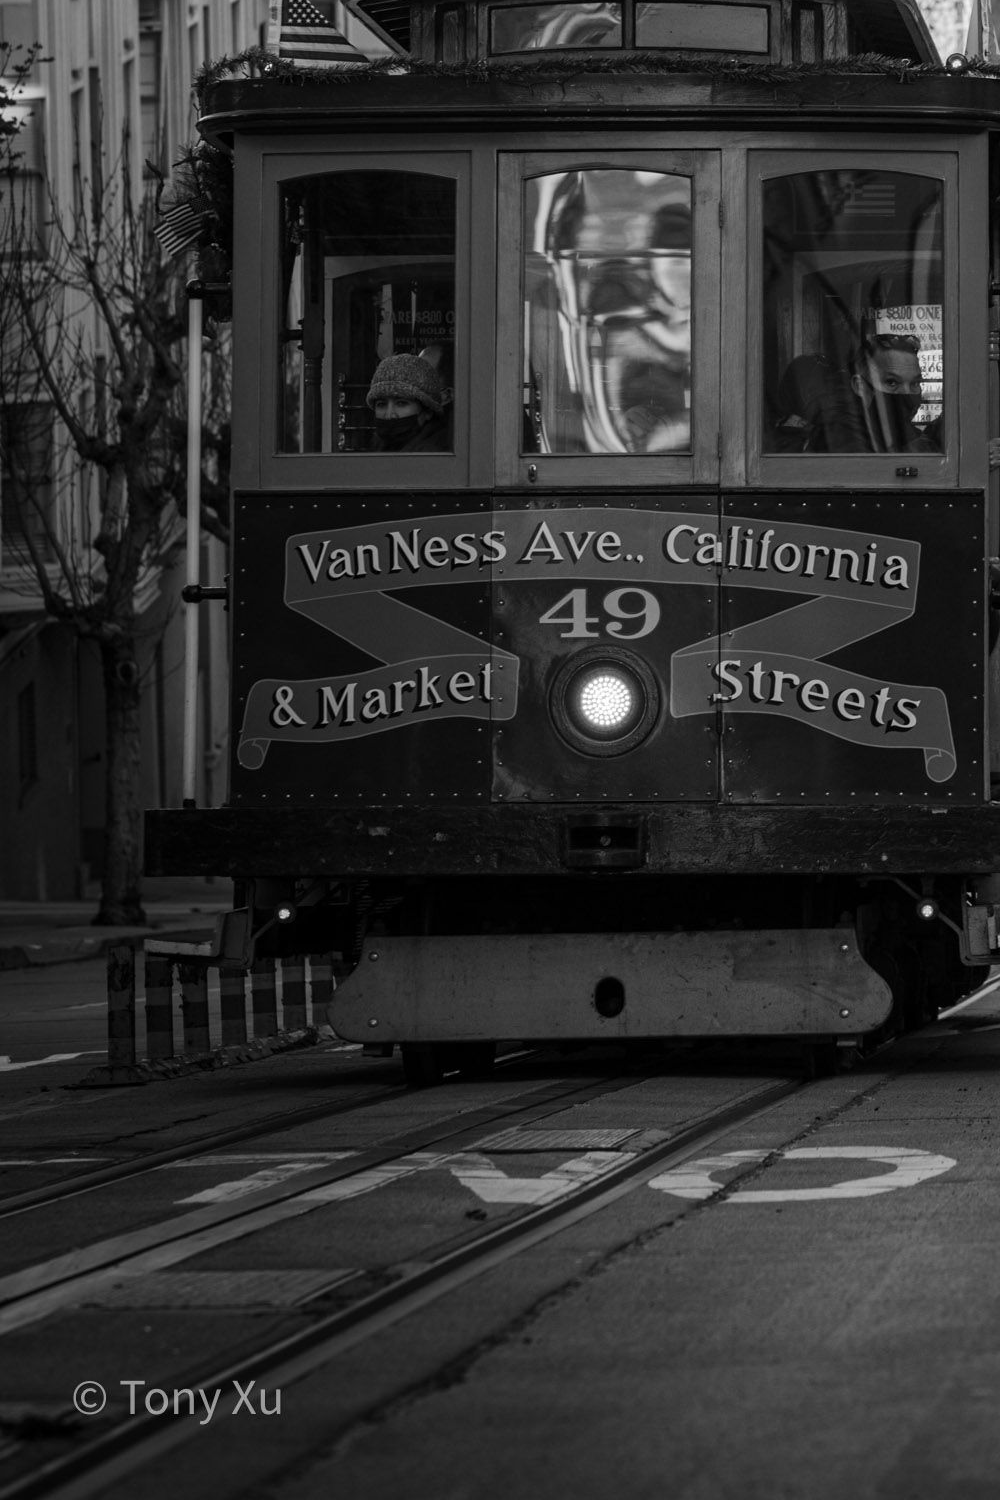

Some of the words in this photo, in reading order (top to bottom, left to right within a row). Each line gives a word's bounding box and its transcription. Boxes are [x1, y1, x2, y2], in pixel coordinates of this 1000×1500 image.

[890, 323, 915, 331] HOLD
[919, 323, 934, 331] ON
[916, 306, 941, 319] ONE
[299, 540, 382, 582] Van
[389, 528, 507, 570] Ness
[522, 521, 644, 563] Ave.,
[665, 524, 910, 589] California
[539, 587, 661, 640] 49
[273, 686, 307, 726] &
[320, 662, 491, 724] Market
[713, 660, 921, 729] Streets
